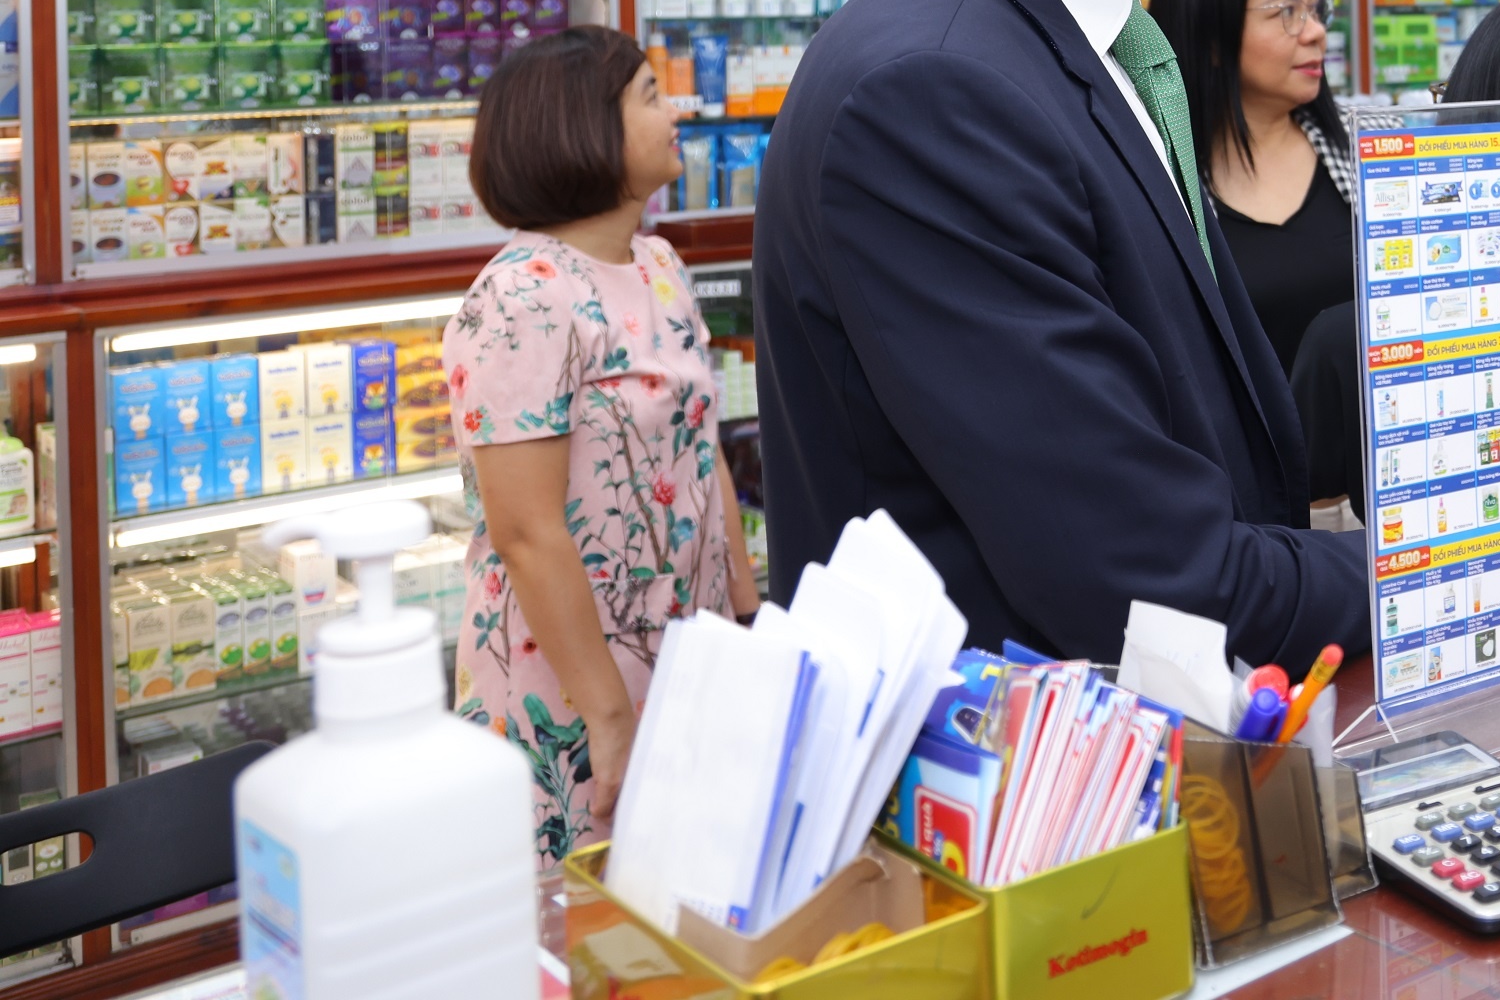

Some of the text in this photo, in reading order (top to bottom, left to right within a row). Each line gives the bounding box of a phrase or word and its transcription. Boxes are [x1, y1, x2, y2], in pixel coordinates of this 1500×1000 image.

[1373, 137, 1403, 155] 1.500
[1433, 139, 1452, 151] PHIẾU
[1453, 141, 1468, 150] MUA
[1469, 138, 1489, 149] HÀNG
[1380, 344, 1414, 362] 3.000
[1441, 342, 1460, 355] PHIẾU
[1461, 340, 1477, 350] MUA
[1477, 336, 1498, 349] HÀNG
[1388, 549, 1421, 571] 4.500
[1446, 545, 1467, 559] PHIẾU
[1467, 543, 1483, 555] MUA
